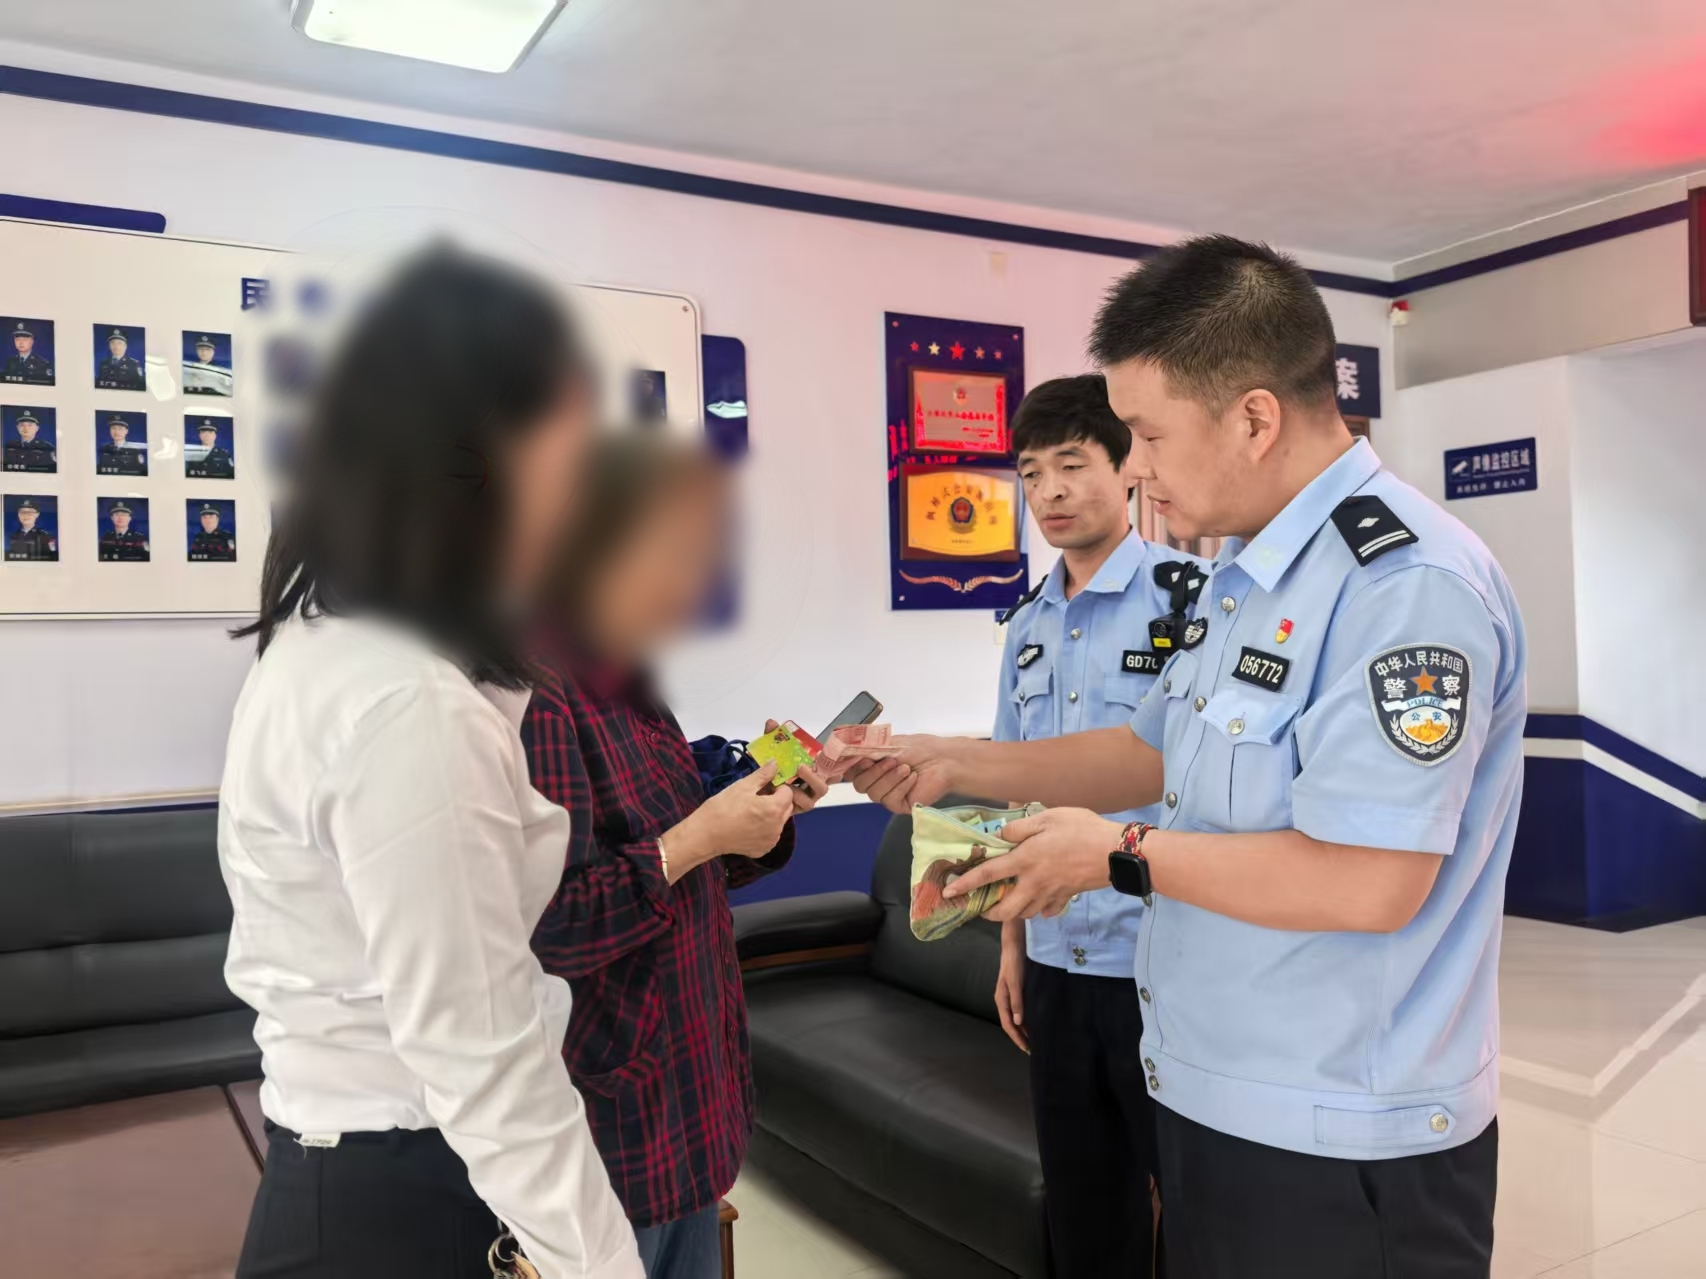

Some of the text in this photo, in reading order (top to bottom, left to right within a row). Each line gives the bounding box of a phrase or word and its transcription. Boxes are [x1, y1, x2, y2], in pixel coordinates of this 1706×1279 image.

[1240, 655, 1283, 684] 056772
[1374, 650, 1463, 677] 中华人民共和国
[1407, 697, 1444, 709] POLICE
